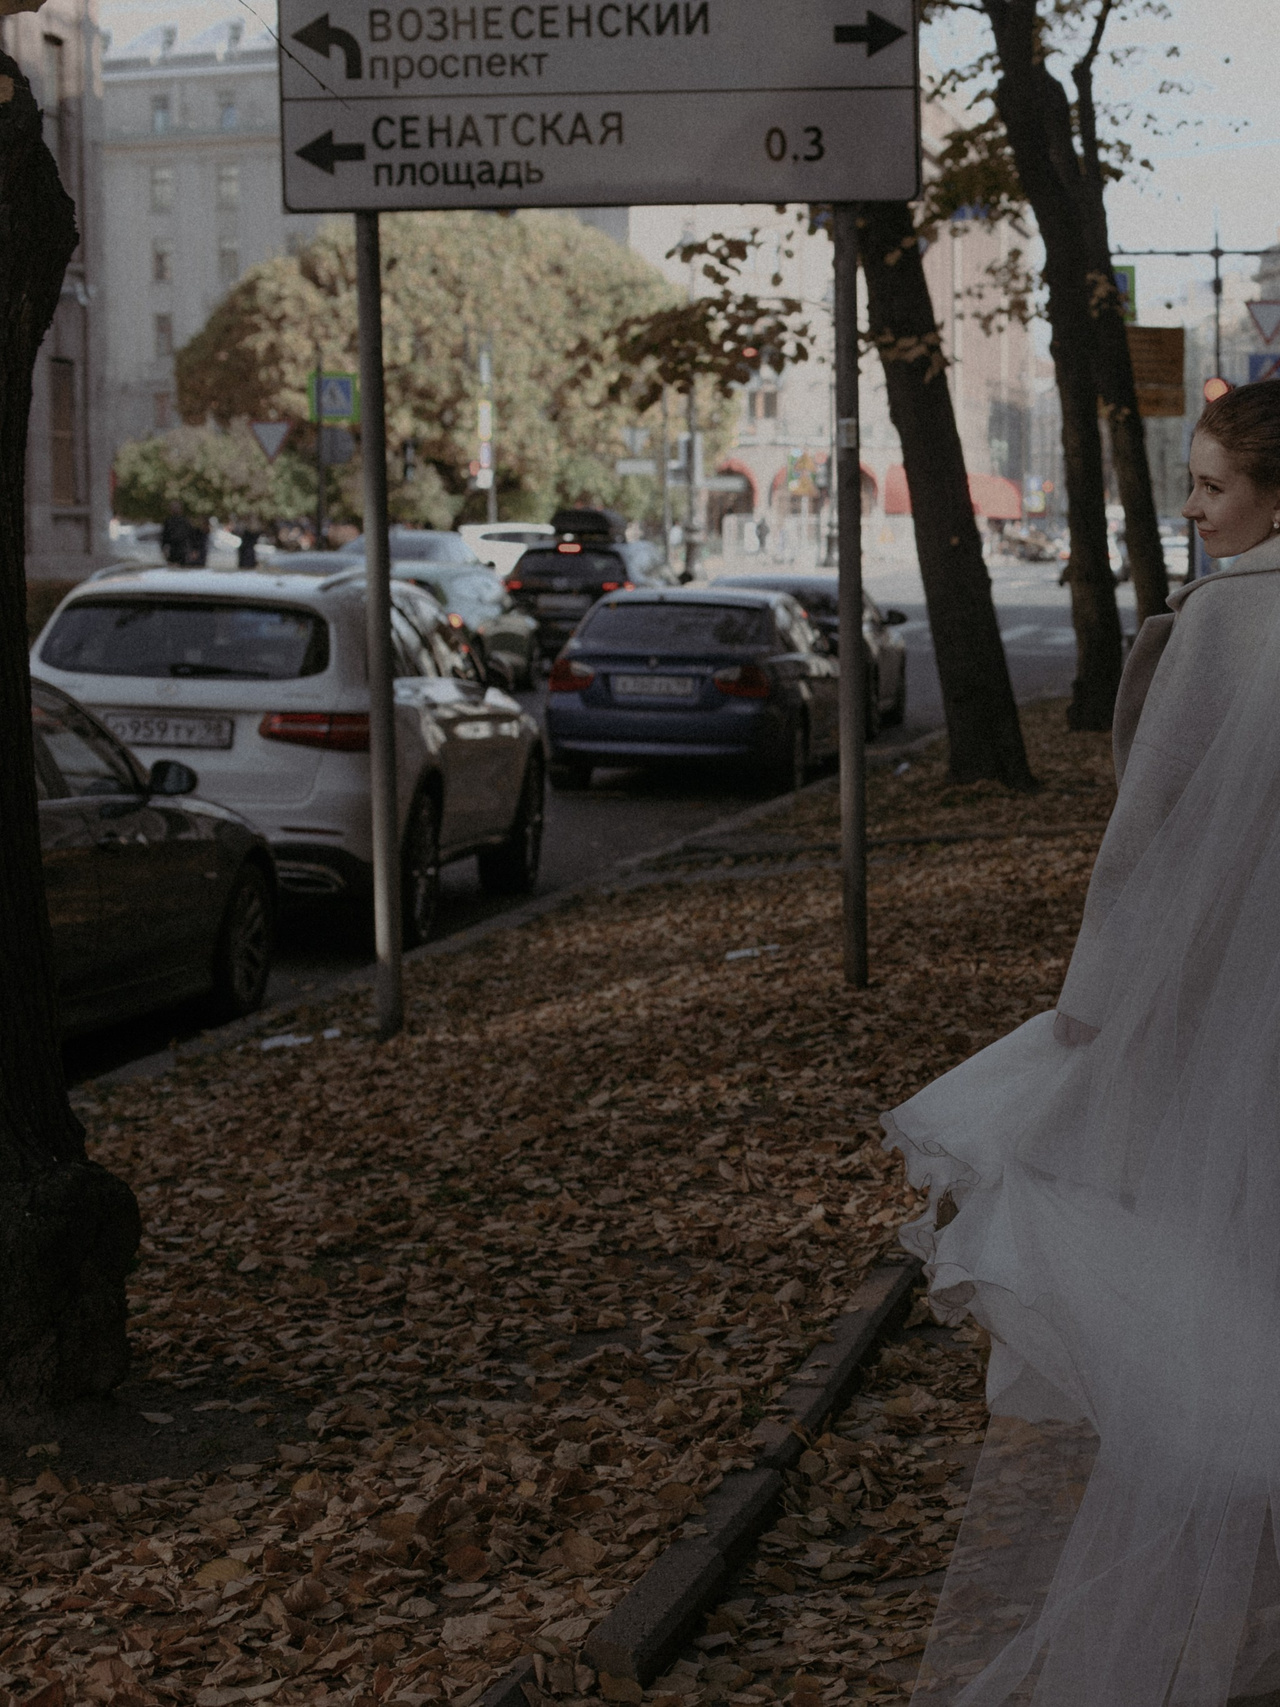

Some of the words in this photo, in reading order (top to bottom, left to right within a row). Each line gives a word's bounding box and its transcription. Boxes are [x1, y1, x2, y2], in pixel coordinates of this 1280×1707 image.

[369, 52, 549, 89] проспект
[371, 112, 625, 150] СЕНАТСКАЯ
[764, 126, 826, 162] 0.3
[373, 160, 544, 188] площадь
